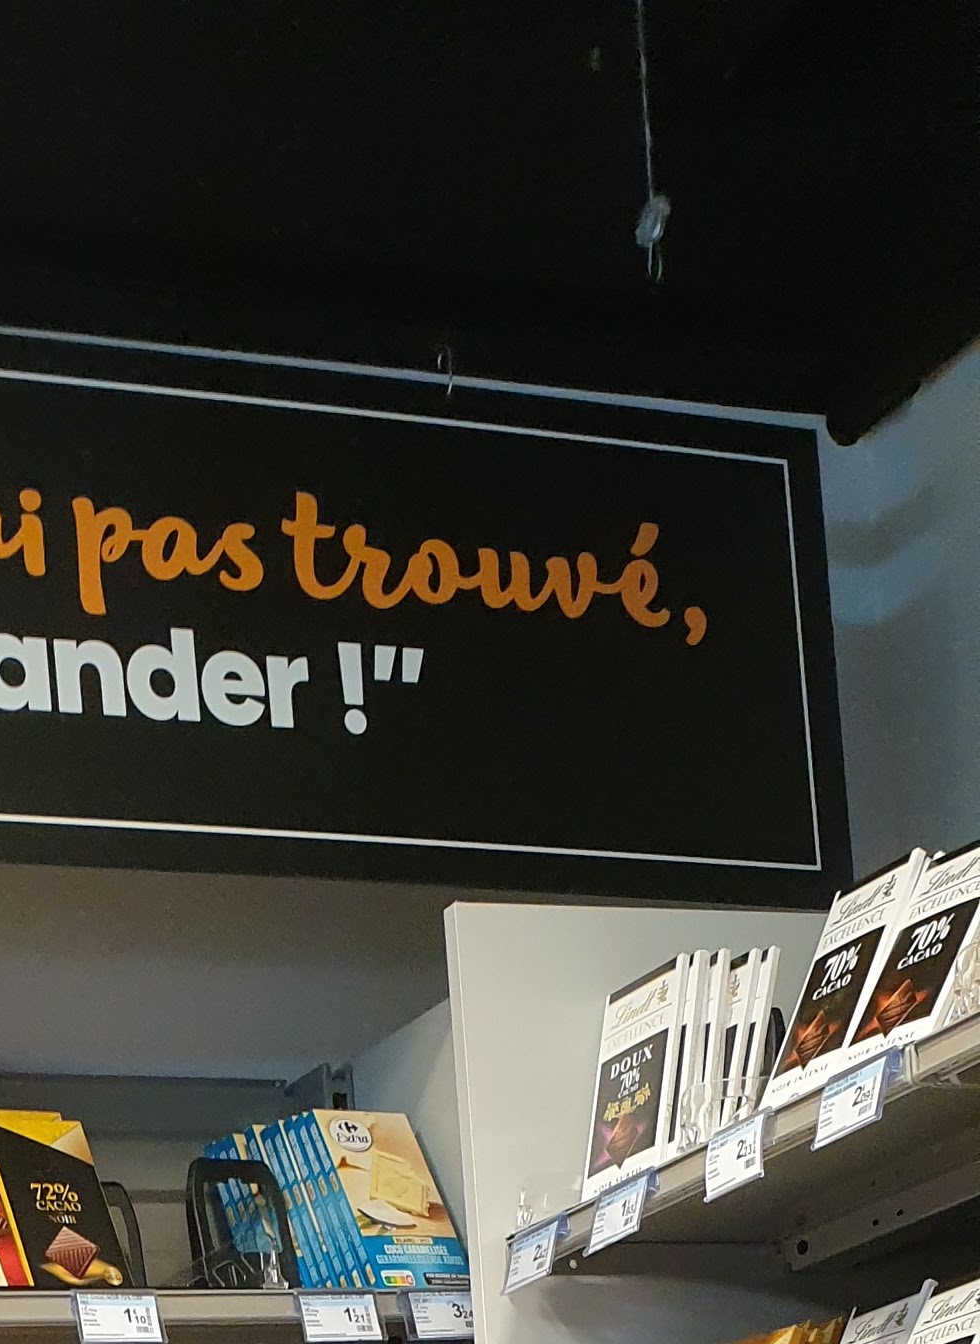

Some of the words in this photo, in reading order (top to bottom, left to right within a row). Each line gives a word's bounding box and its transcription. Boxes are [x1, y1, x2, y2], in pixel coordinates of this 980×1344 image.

[72, 496, 264, 616] pas
[282, 492, 707, 646] trouvé,
[928, 860, 971, 897] Lindt
[836, 889, 881, 924] Lindt
[823, 907, 888, 950] EXCELLENCE
[909, 911, 956, 950] 70%
[821, 942, 864, 981] 70%
[896, 941, 944, 971] CACAO
[811, 973, 853, 1002] CACAO
[610, 1044, 656, 1081] DOUX
[30, 1182, 78, 1203] 72%
[36, 1200, 82, 1213] CACAO
[923, 1288, 973, 1327] Lindt
[849, 1310, 894, 1344] Lindt
